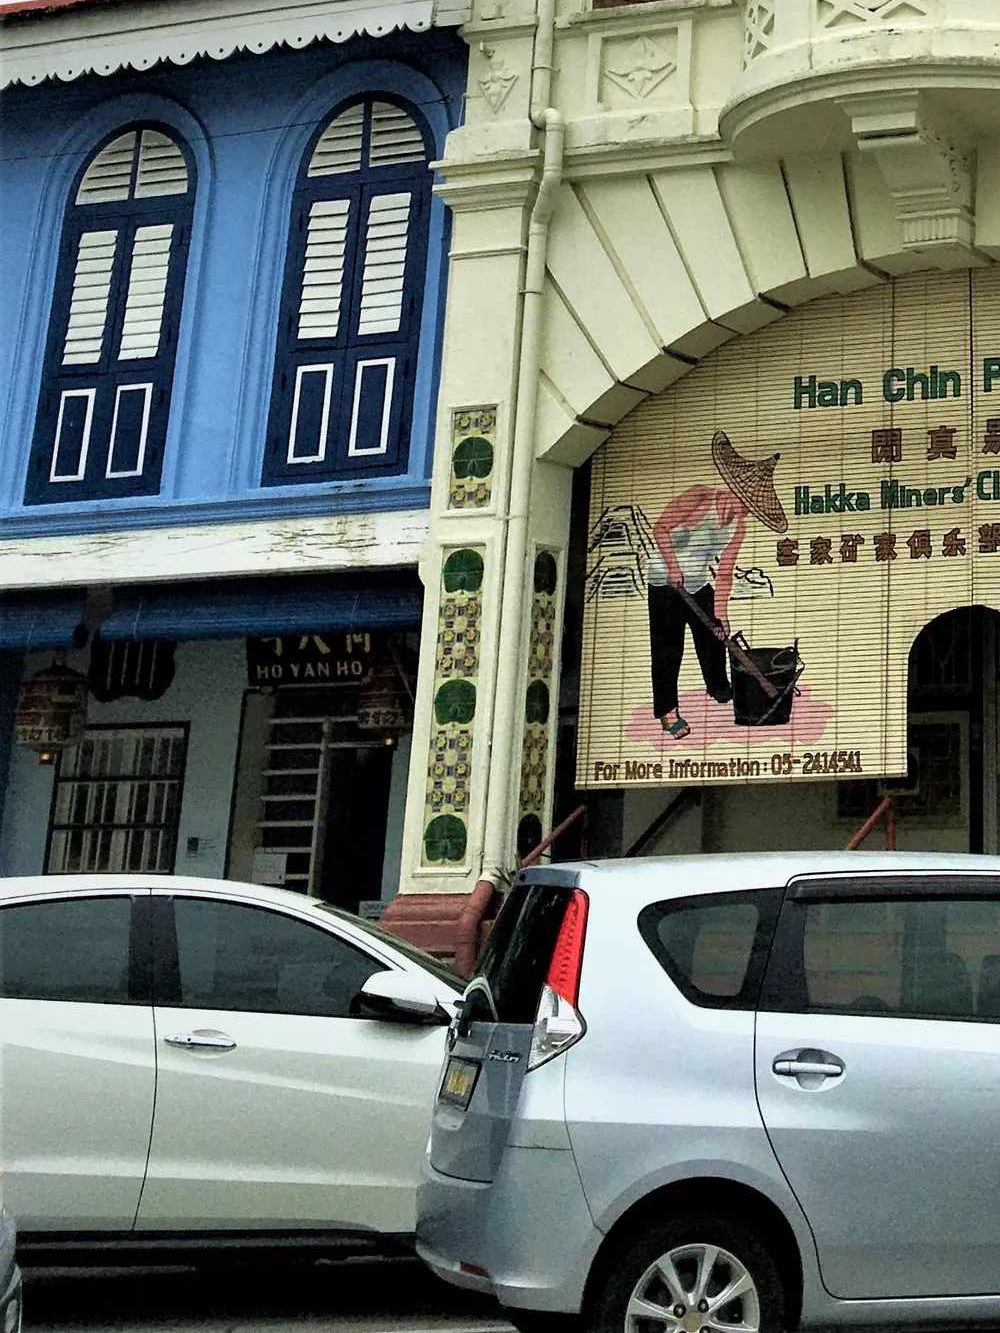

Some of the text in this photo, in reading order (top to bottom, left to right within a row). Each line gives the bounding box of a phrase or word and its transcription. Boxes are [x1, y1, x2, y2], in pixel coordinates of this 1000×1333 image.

[793, 374, 863, 410] Han
[882, 365, 962, 403] Chin
[794, 482, 871, 515] Hakka
[880, 475, 972, 509] Miners'
[256, 664, 283, 680] HO
[290, 662, 330, 678] YAN
[594, 761, 620, 781] For
[624, 760, 663, 780] More
